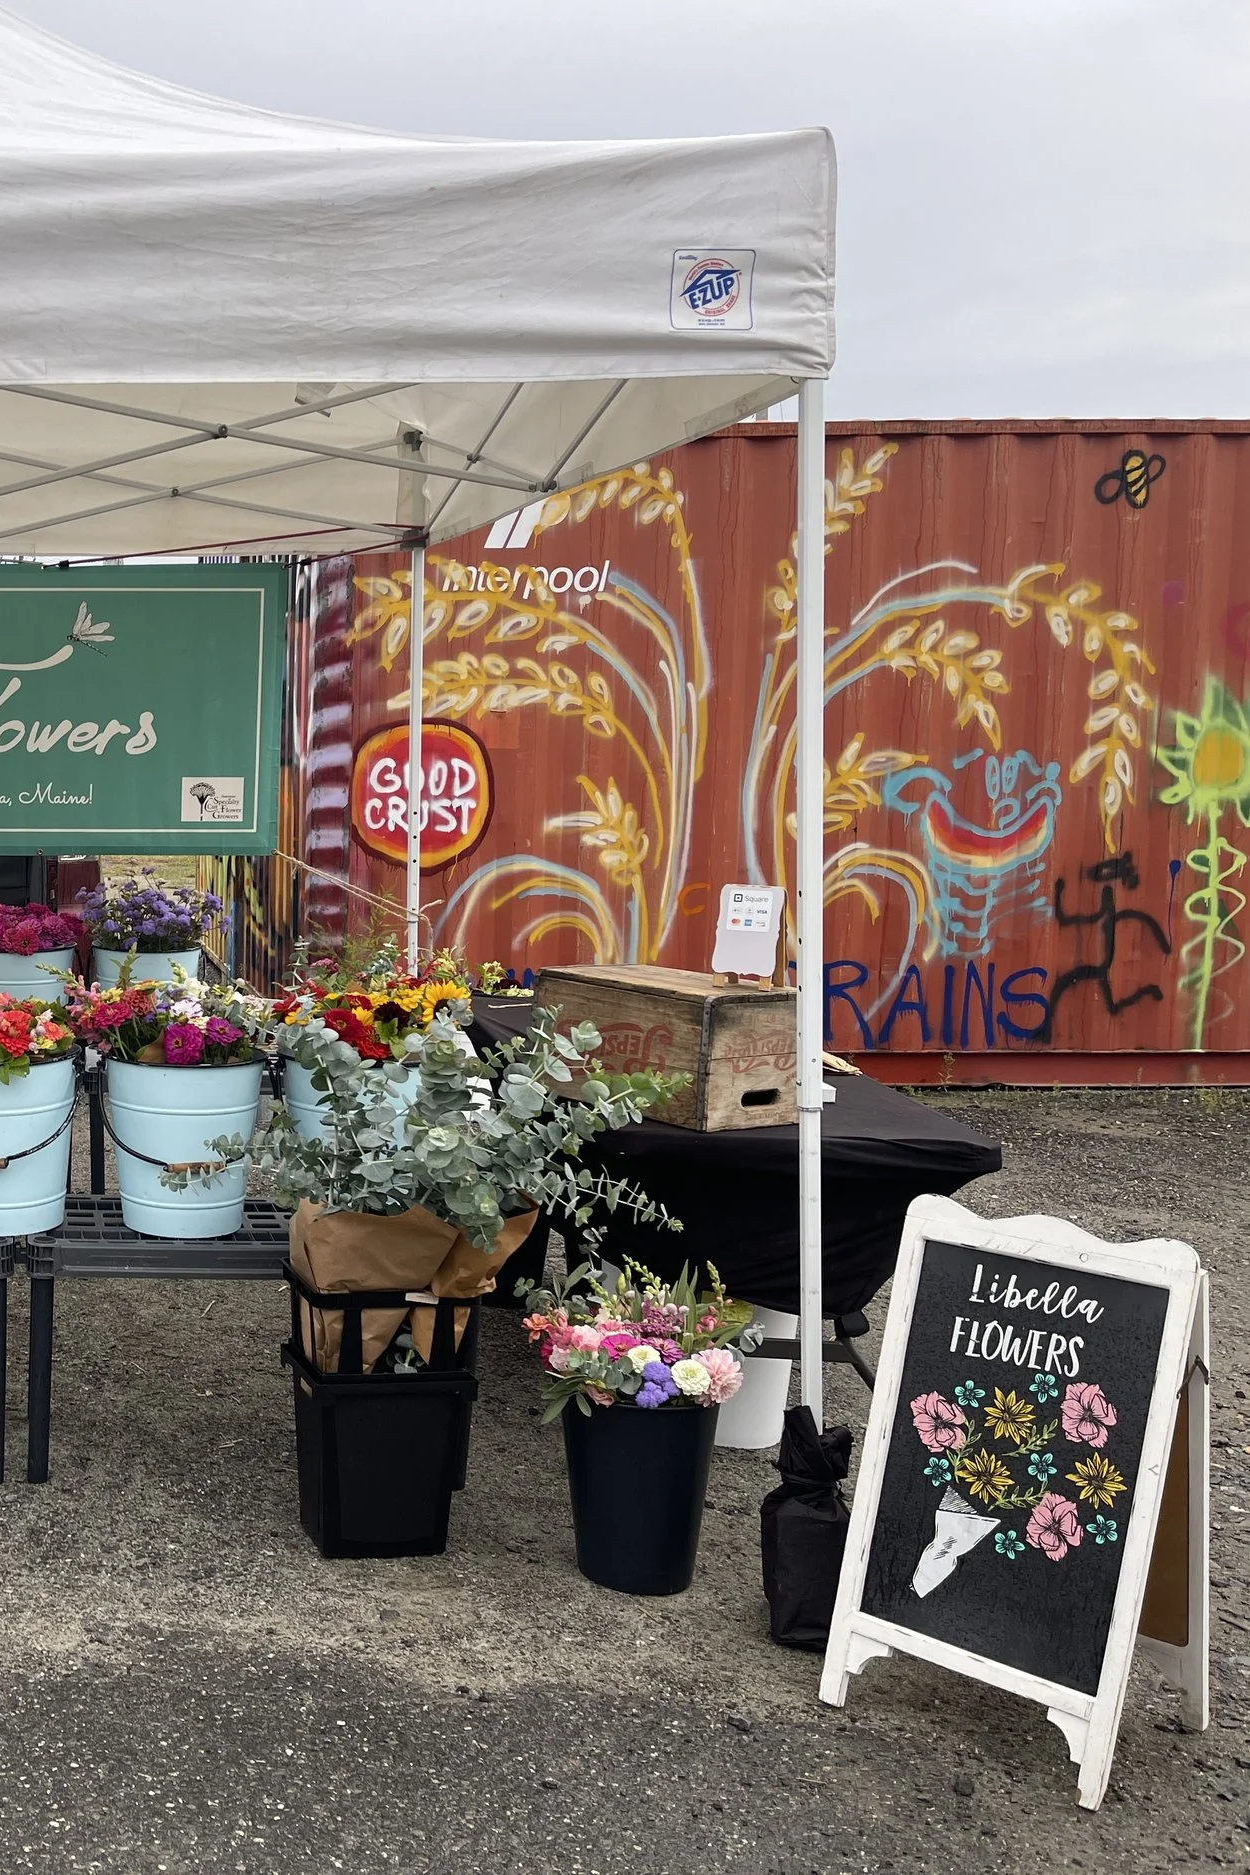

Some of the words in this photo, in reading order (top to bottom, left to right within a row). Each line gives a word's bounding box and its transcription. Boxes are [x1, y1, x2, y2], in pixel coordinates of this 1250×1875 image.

[442, 559, 611, 600] Interpool
[19, 782, 93, 805] Maine!
[744, 895, 769, 903] Square
[788, 959, 1050, 1050] RAINS
[968, 1264, 1105, 1324] Libella
[950, 1316, 1085, 1378] FLOWERS
